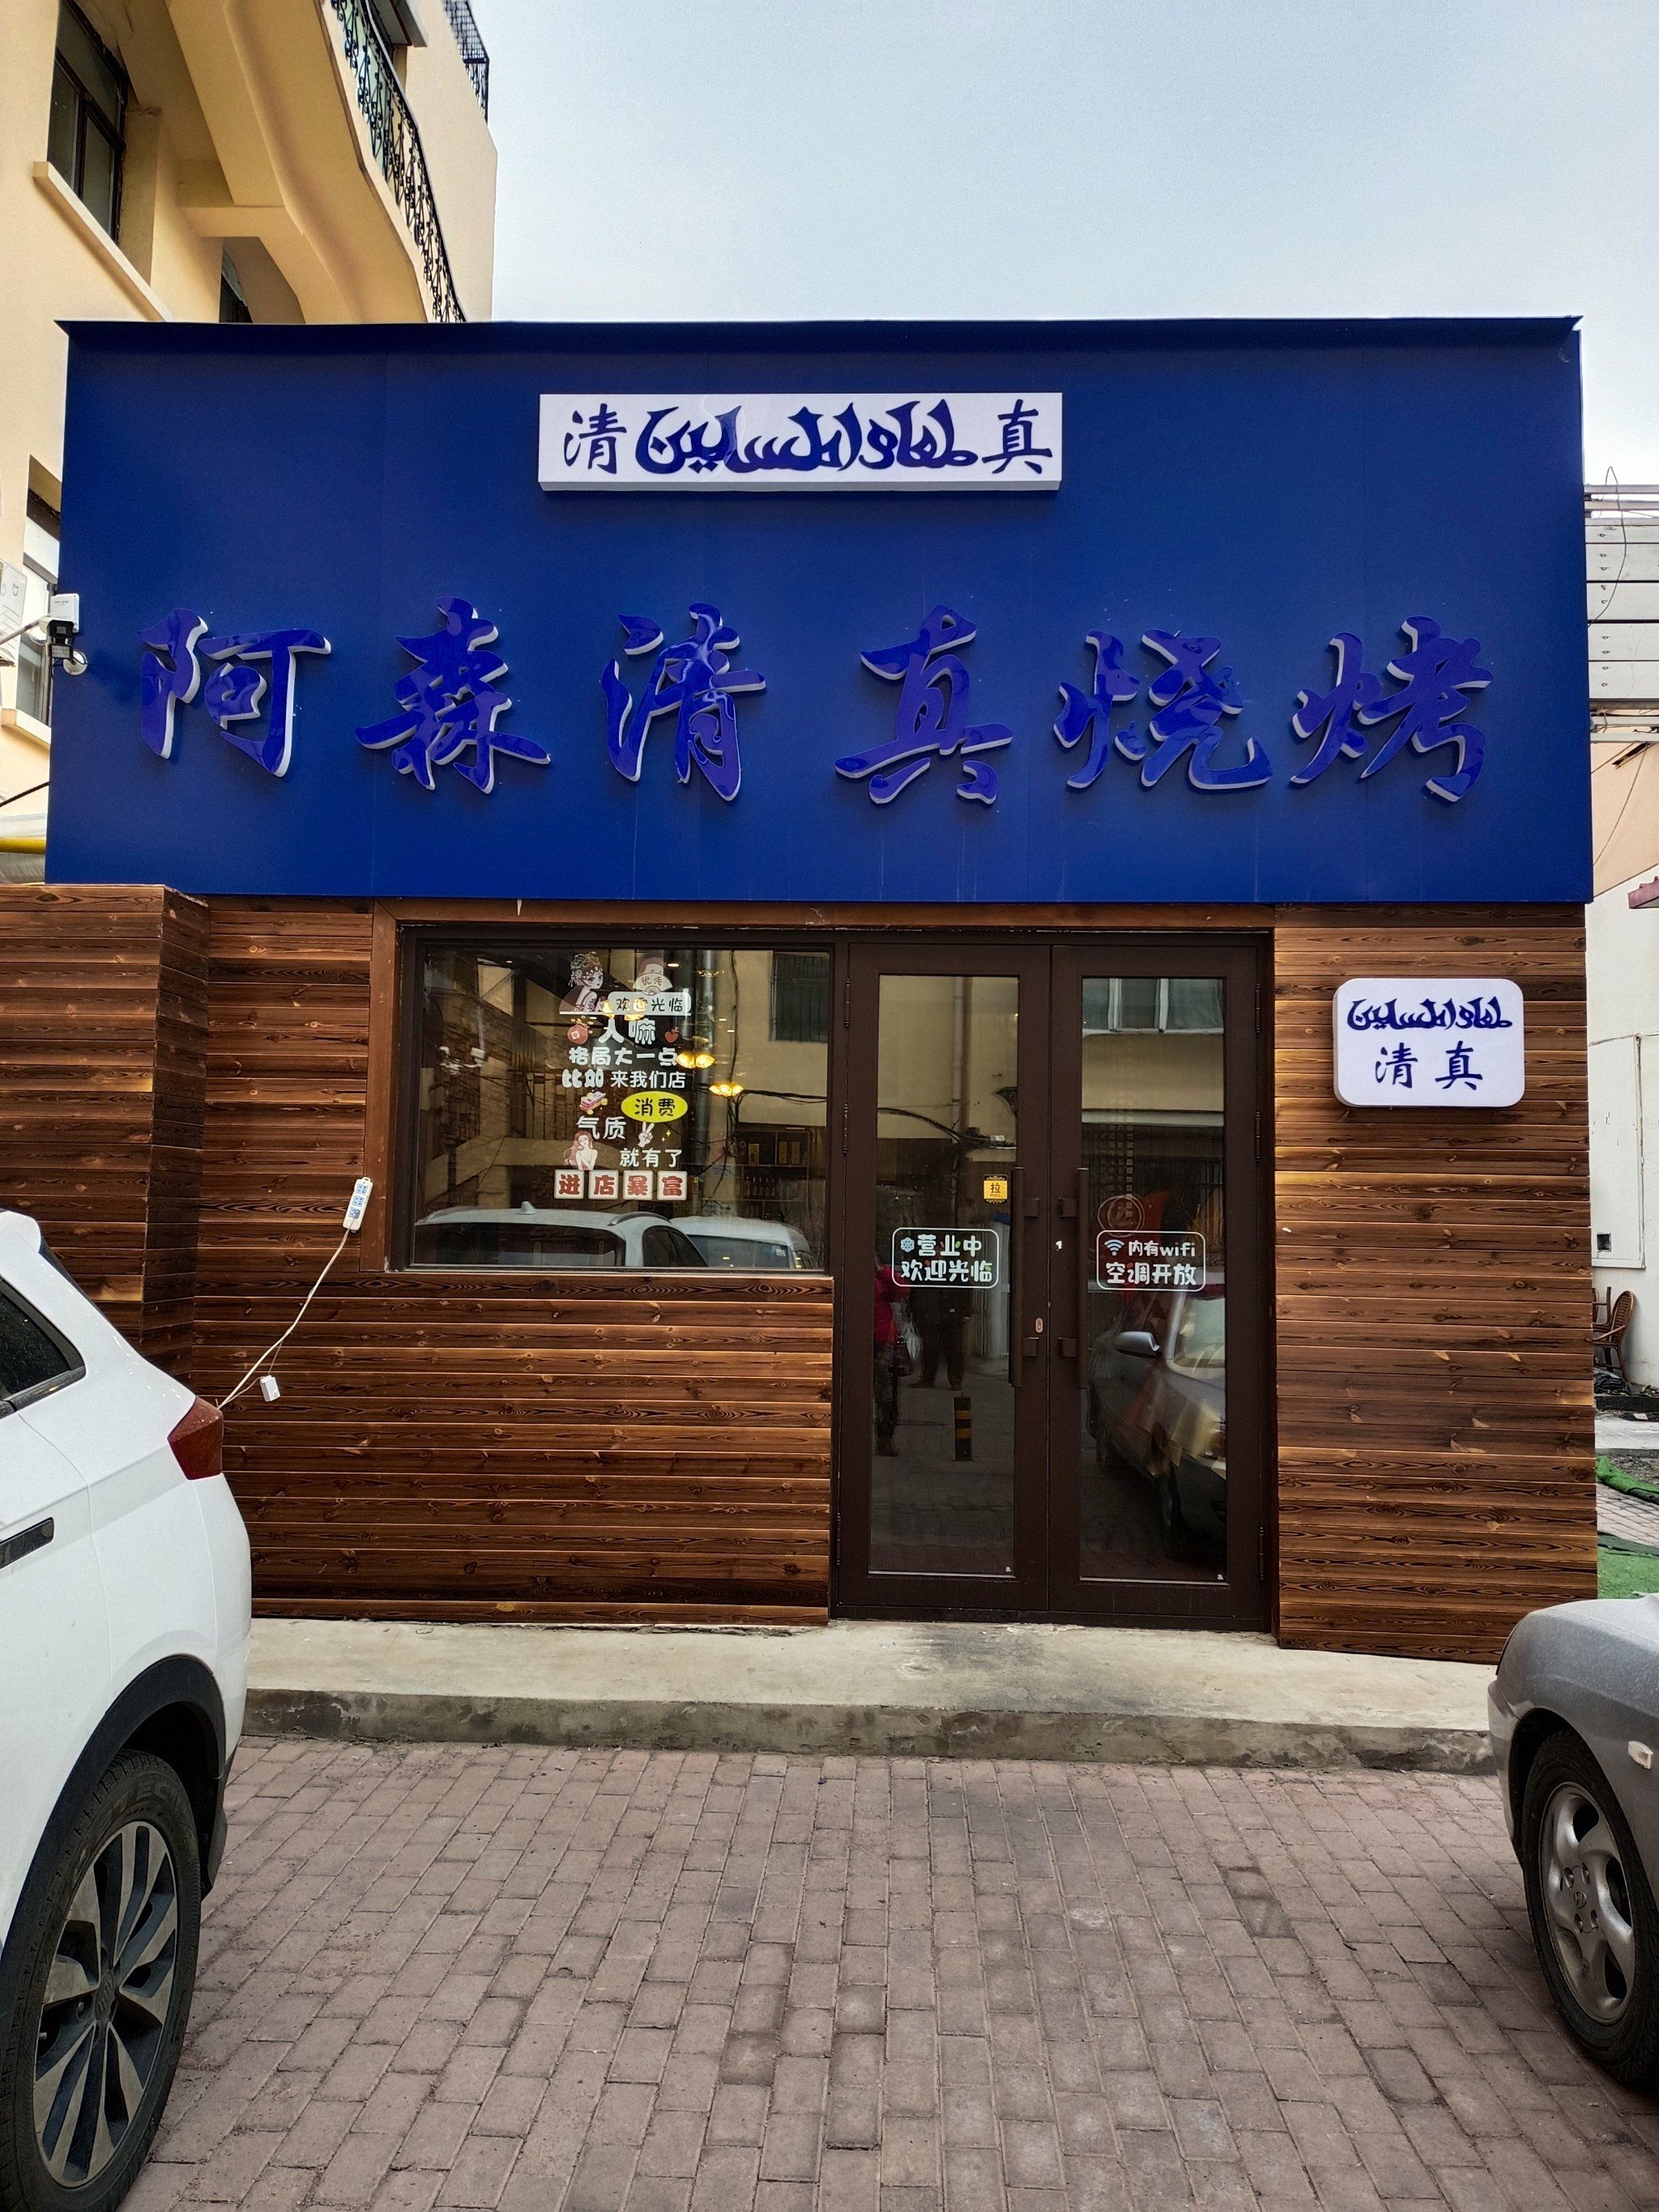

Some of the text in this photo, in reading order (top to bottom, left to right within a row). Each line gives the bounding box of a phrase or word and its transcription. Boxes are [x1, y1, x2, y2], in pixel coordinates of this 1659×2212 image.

[598, 1016, 656, 1046] 人嘛
[568, 1046, 678, 1067] 格局大一点
[1375, 1040, 1483, 1091] 清真
[561, 1068, 686, 1089] 比如 来我们店
[634, 1097, 676, 1117] 消费
[575, 1115, 627, 1140] 气质
[619, 1147, 683, 1168] 就有了
[558, 1174, 684, 1197] 进店暴富
[990, 1183, 1001, 1194] 拉
[917, 1234, 983, 1257] 营业中
[900, 1259, 993, 1282] 欢迎光临
[1106, 1261, 1196, 1285] 空调开放
